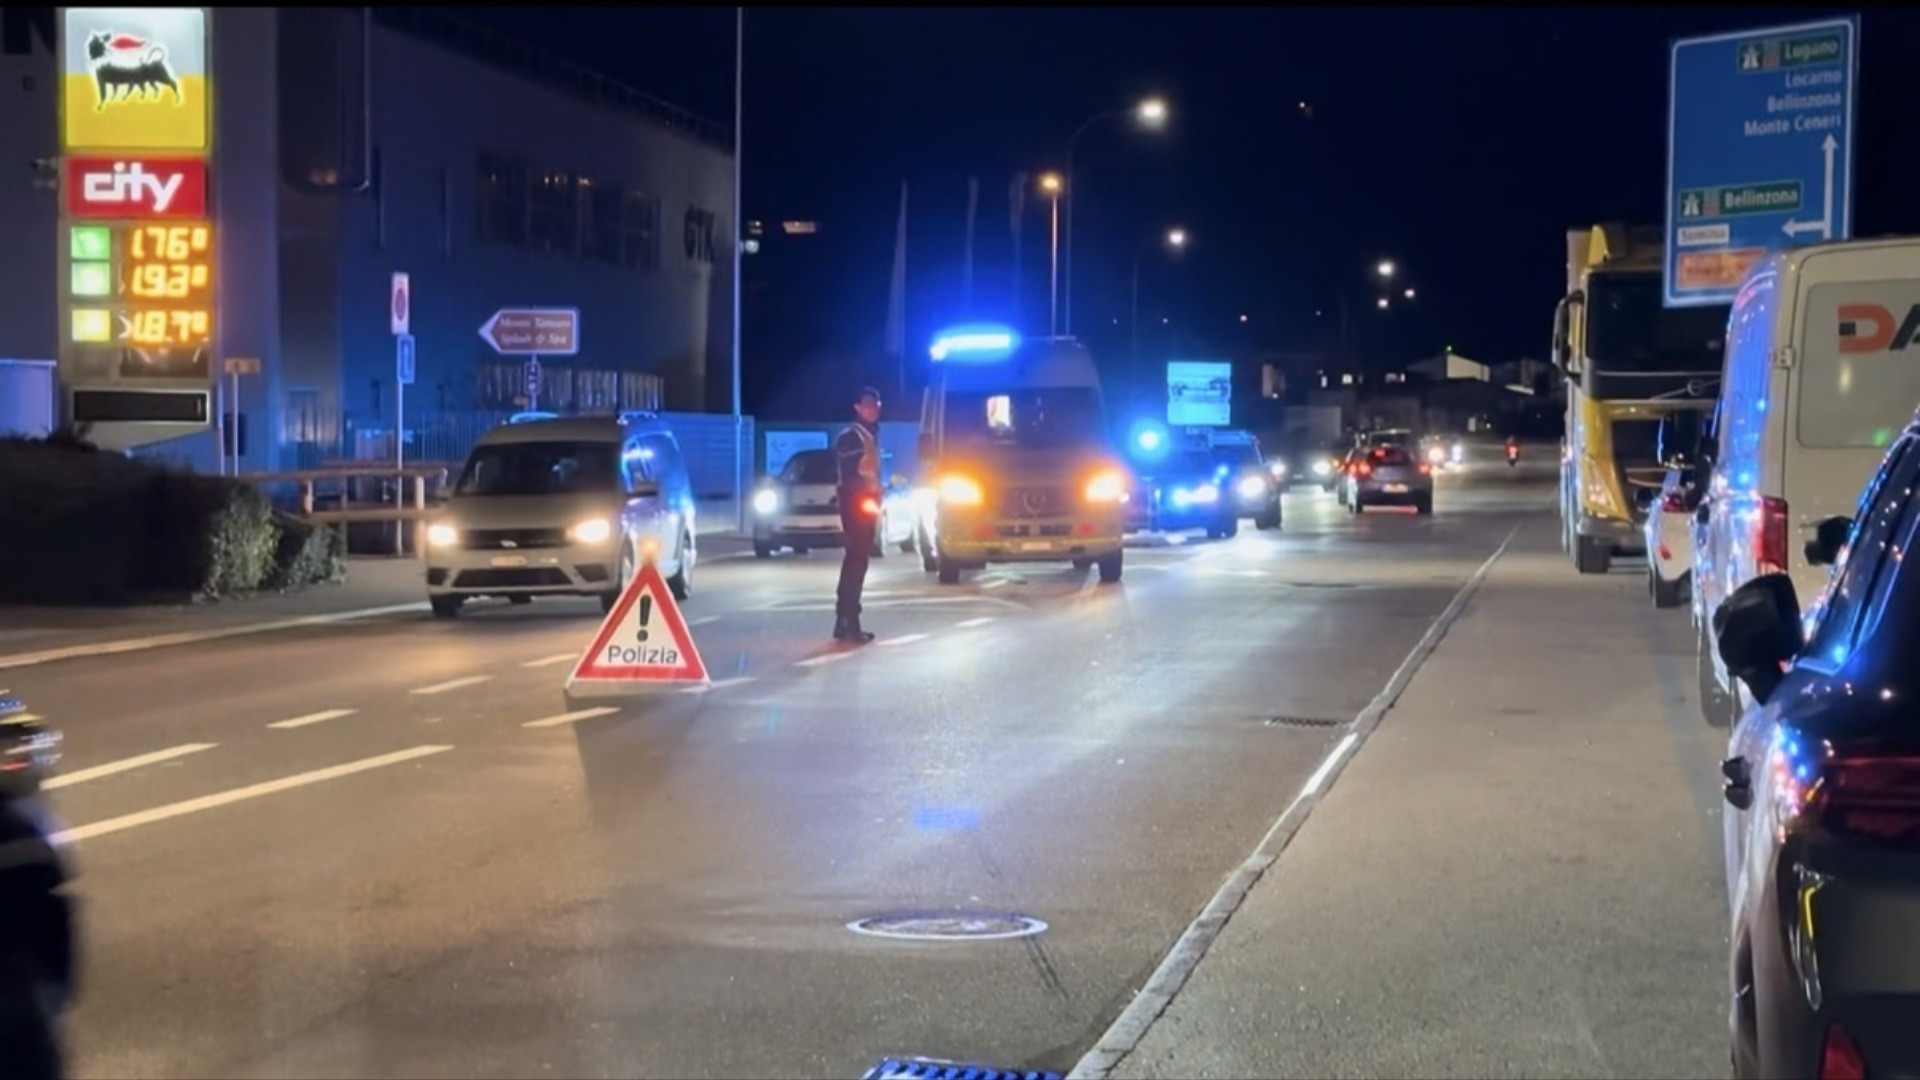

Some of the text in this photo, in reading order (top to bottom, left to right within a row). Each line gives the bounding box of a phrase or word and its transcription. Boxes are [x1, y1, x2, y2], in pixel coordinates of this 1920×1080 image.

[1785, 39, 1838, 61] Lugano
[1785, 70, 1842, 88] Locarno
[1767, 91, 1842, 113] Bellinzona
[1744, 114, 1841, 136] Monte Ceneri
[84, 162, 184, 212] city
[1724, 188, 1798, 209] Bellinzona
[608, 645, 678, 664] Polizia
